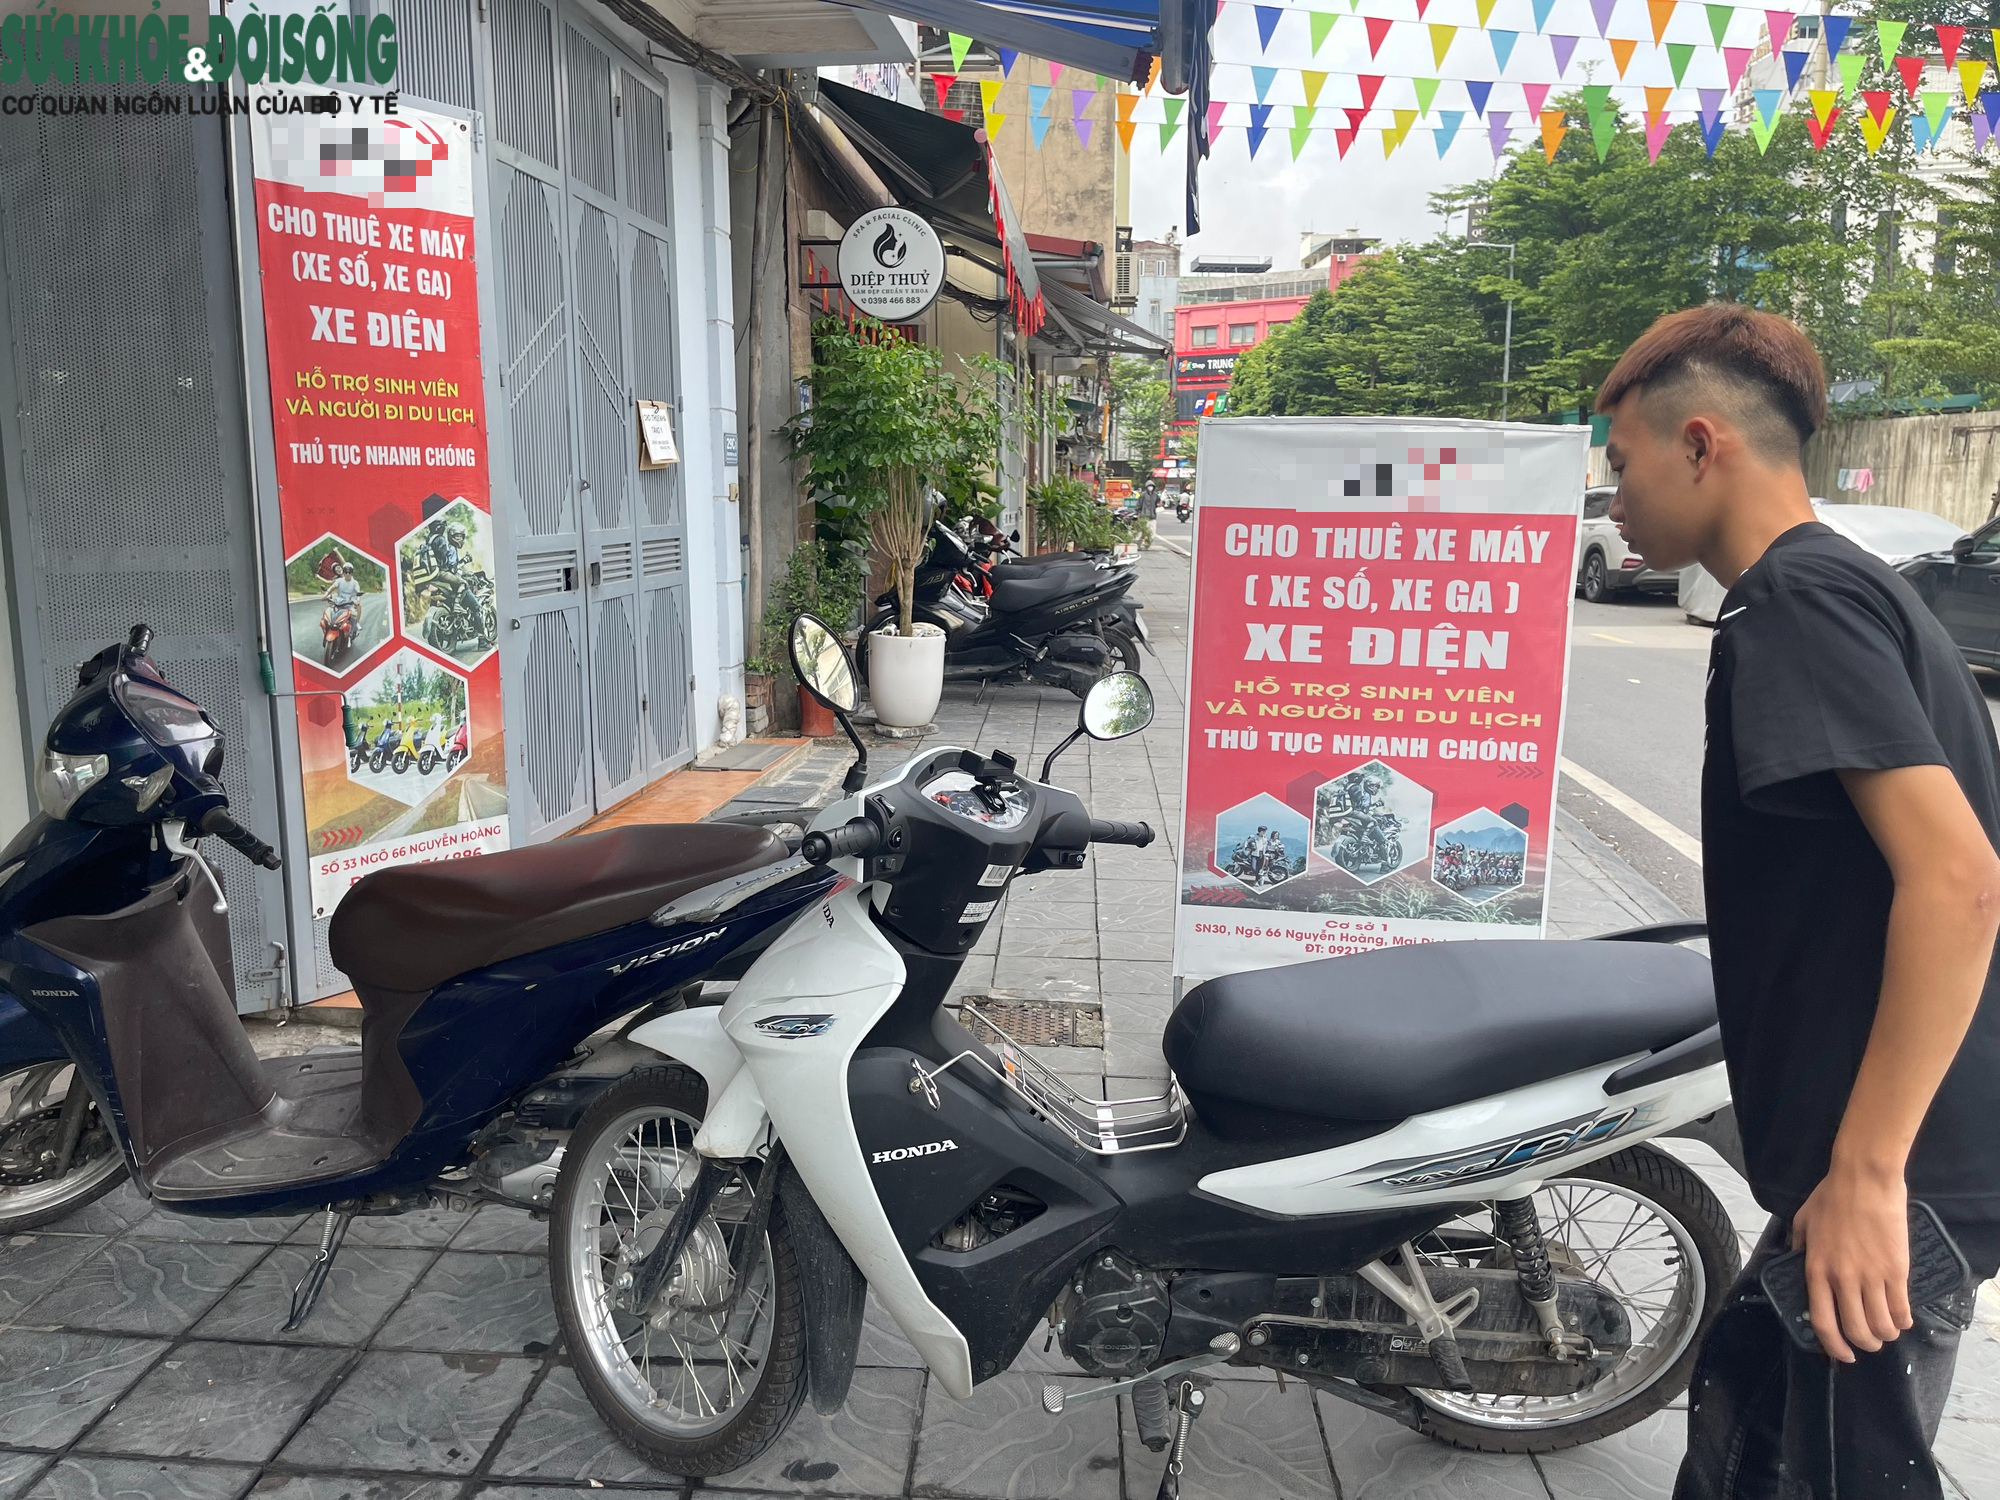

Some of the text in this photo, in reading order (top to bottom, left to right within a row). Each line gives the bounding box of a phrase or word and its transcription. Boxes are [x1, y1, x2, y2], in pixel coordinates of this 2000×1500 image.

[267, 203, 466, 260] CHO THUÊ XE MÁY
[853, 224, 865, 238] SPA
[872, 212, 901, 221] FACIAL
[902, 216, 927, 237] CLINIC
[292, 250, 451, 300] (XE SỐ, XE GA)
[851, 269, 930, 289] DIỆP THUỶ
[868, 297, 888, 305] 0398
[906, 296, 921, 304] 883
[309, 305, 446, 358] XE ĐIỆN
[1207, 358, 1234, 370] TRUNG
[296, 366, 459, 398] HỖ TRỢ SINH VIÊN
[285, 397, 474, 426] VÀ NGƯỜI ĐI DU LỊCH
[290, 437, 476, 469] THỦ TỤC NHANH CHÓNG
[1225, 522, 1550, 563] CHO THUÊ XE MÁY
[1269, 575, 1311, 608] XE
[1323, 567, 1378, 613] SỐ,
[1390, 579, 1433, 612] XE
[1445, 580, 1493, 613] GA
[1244, 622, 1509, 675] XE ĐIỆN
[1234, 676, 1515, 704] HỖ TRỢ SINH VIÊN
[1205, 699, 1542, 729] VÀ NGƯỜI ĐI DU LỊCH
[1204, 726, 1538, 763] THỦ TỤC NHANH CHÓNG
[321, 859, 340, 875] SỐ
[344, 858, 357, 870] 33
[360, 849, 389, 867] NGÕ
[392, 847, 406, 859] 66
[410, 834, 458, 855] NGUYỄN
[461, 825, 501, 843] HOÀNG
[1195, 923, 1231, 936] SN30,
[1235, 926, 1261, 938] Ngõ
[1265, 928, 1282, 938] 66
[1285, 929, 1335, 942] Nguyễn
[1340, 932, 1388, 947] Hoàng,
[1325, 920, 1388, 931] Cơ sở 1
[606, 926, 727, 976] VISION
[1305, 943, 1324, 954] ĐT:
[31, 989, 80, 997] HONDA
[872, 1139, 959, 1164] HONDA
